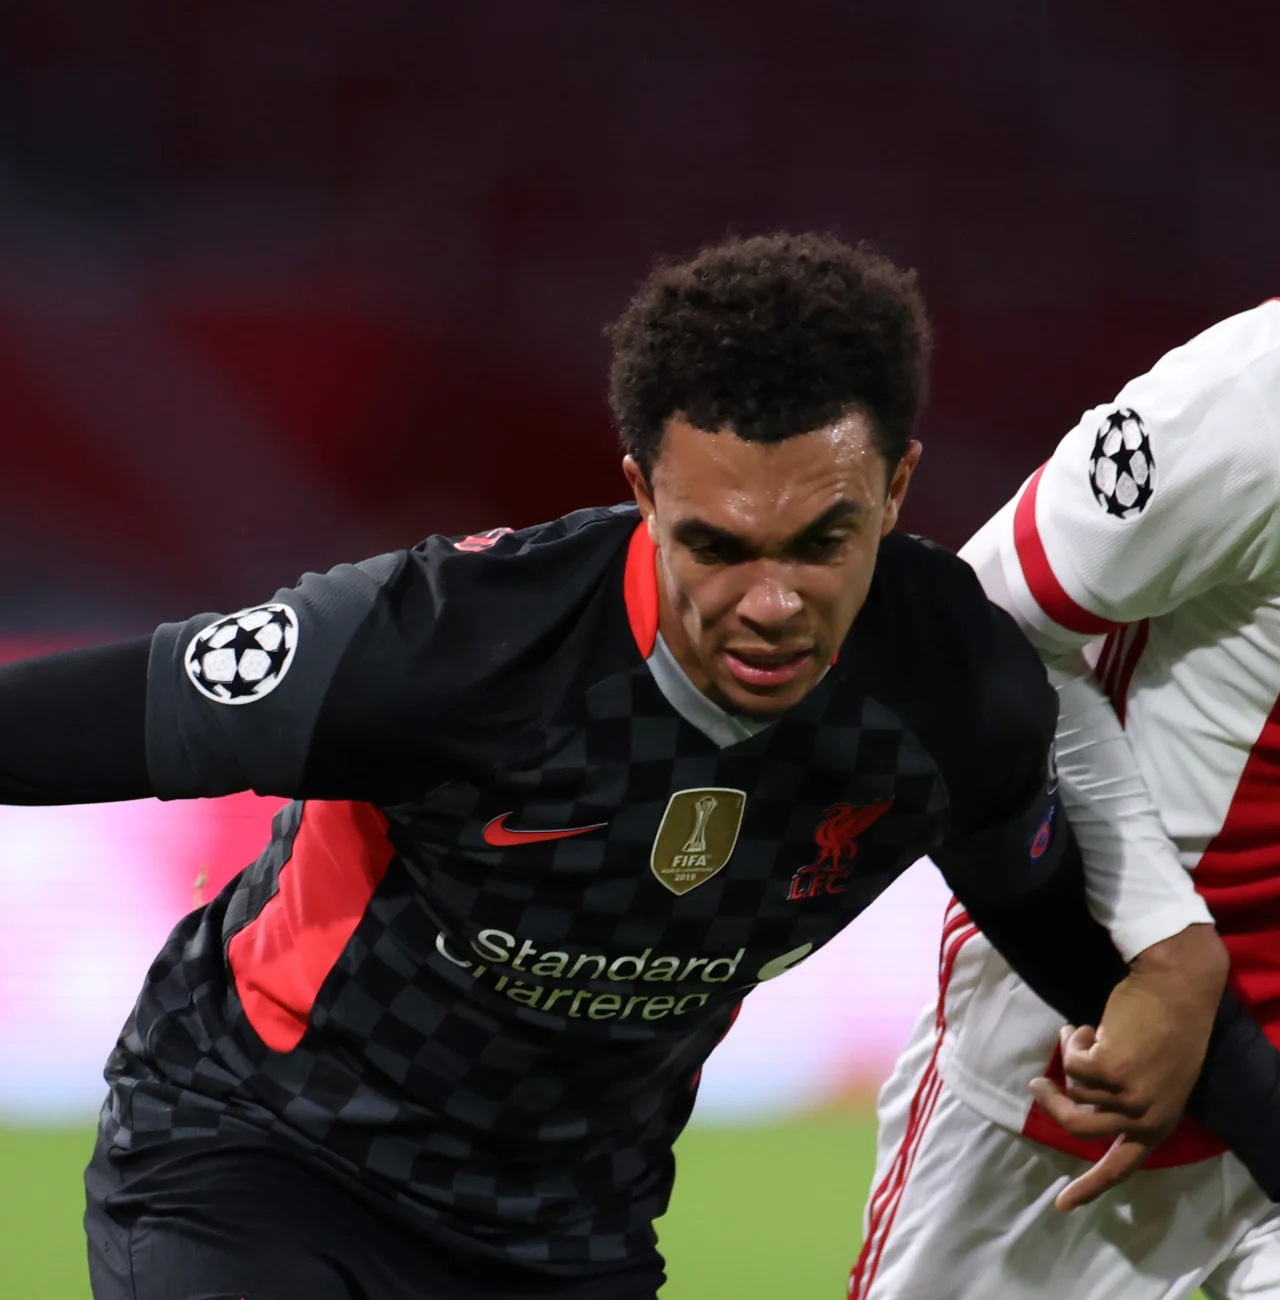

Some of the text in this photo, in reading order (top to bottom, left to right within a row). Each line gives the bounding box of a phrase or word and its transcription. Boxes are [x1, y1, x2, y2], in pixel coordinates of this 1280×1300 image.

[672, 855, 707, 868] FIFA
[675, 874, 697, 882] 2019
[471, 928, 745, 984] Standard
[435, 931, 710, 1021] Cartere
